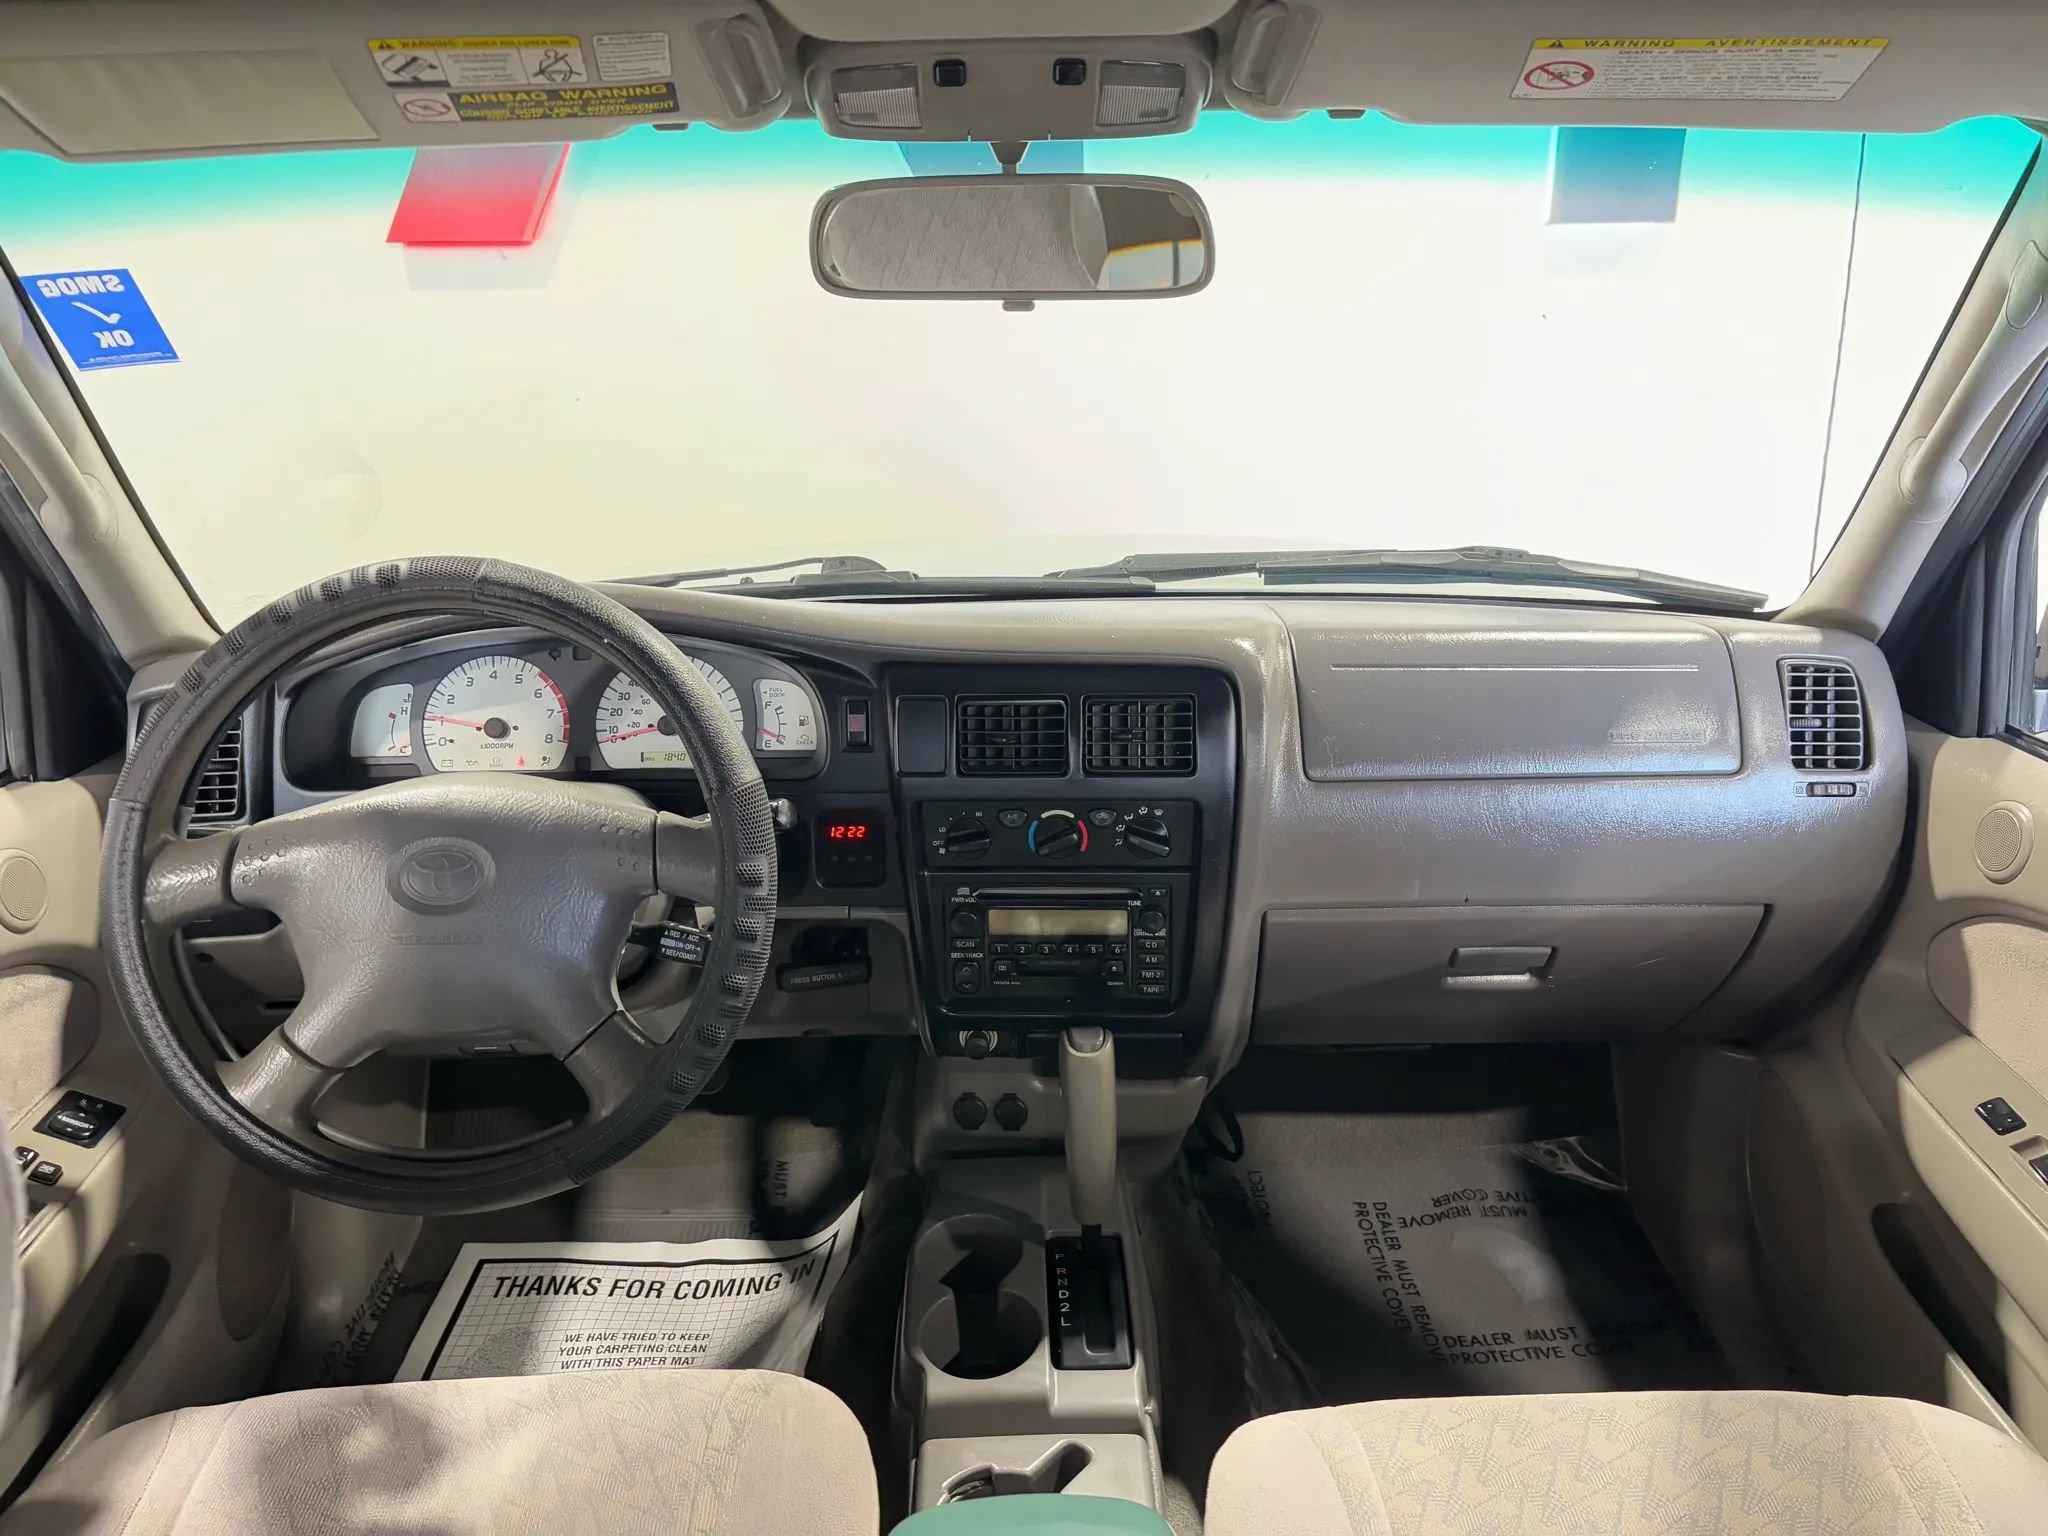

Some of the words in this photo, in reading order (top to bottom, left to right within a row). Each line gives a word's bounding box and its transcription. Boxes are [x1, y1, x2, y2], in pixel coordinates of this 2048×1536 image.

[460, 92, 548, 104] AIRBAG
[559, 84, 667, 100] WARNING
[489, 670, 498, 680] 4
[516, 674, 524, 684] 5
[466, 677, 474, 687] 3
[446, 694, 455, 704] 2
[534, 689, 543, 699] 6
[618, 692, 631, 701] 30
[765, 701, 773, 709] F
[401, 707, 408, 715] H
[547, 709, 555, 719] 7
[610, 708, 623, 717] 20
[608, 725, 619, 734] 10
[438, 737, 447, 746] 0
[545, 734, 554, 744] 8
[764, 740, 772, 748] E
[1007, 812, 1019, 820] A/C
[669, 930, 681, 938] RES
[687, 934, 700, 943] ACC
[1145, 941, 1158, 949] CD
[790, 976, 811, 985] PRESS
[773, 1159, 790, 1198] MUST
[1481, 1204, 1528, 1218] MUST
[1398, 1204, 1471, 1229] REMOVE
[1353, 1201, 1394, 1283] PROTECTIVE
[1372, 1201, 1402, 1252] DEALER
[1392, 1259, 1421, 1297] MUST
[1056, 1267, 1067, 1275] R
[492, 1275, 601, 1299] THANKS
[608, 1278, 664, 1299] FOR
[673, 1271, 783, 1300] COMING
[790, 1257, 816, 1284] IN
[1057, 1278, 1068, 1286] N
[1058, 1289, 1069, 1299] D
[1060, 1302, 1071, 1312] 2
[1060, 1316, 1072, 1327] L
[564, 1333, 585, 1343] WE
[586, 1332, 619, 1342] HAVE
[622, 1332, 657, 1341] TRIED
[661, 1332, 677, 1341] TO
[679, 1333, 711, 1341] KEEP
[1443, 1331, 1513, 1349] DEALER
[1524, 1325, 1578, 1342] MUST
[558, 1345, 593, 1357] YOUR
[595, 1343, 665, 1354] CARPETING
[667, 1343, 707, 1353] CLEAN
[1448, 1342, 1566, 1365] PROTECTIVE
[560, 1358, 592, 1370] WITH
[594, 1357, 624, 1367] THIS
[627, 1356, 667, 1366] PAPER
[670, 1356, 696, 1366] MAT
